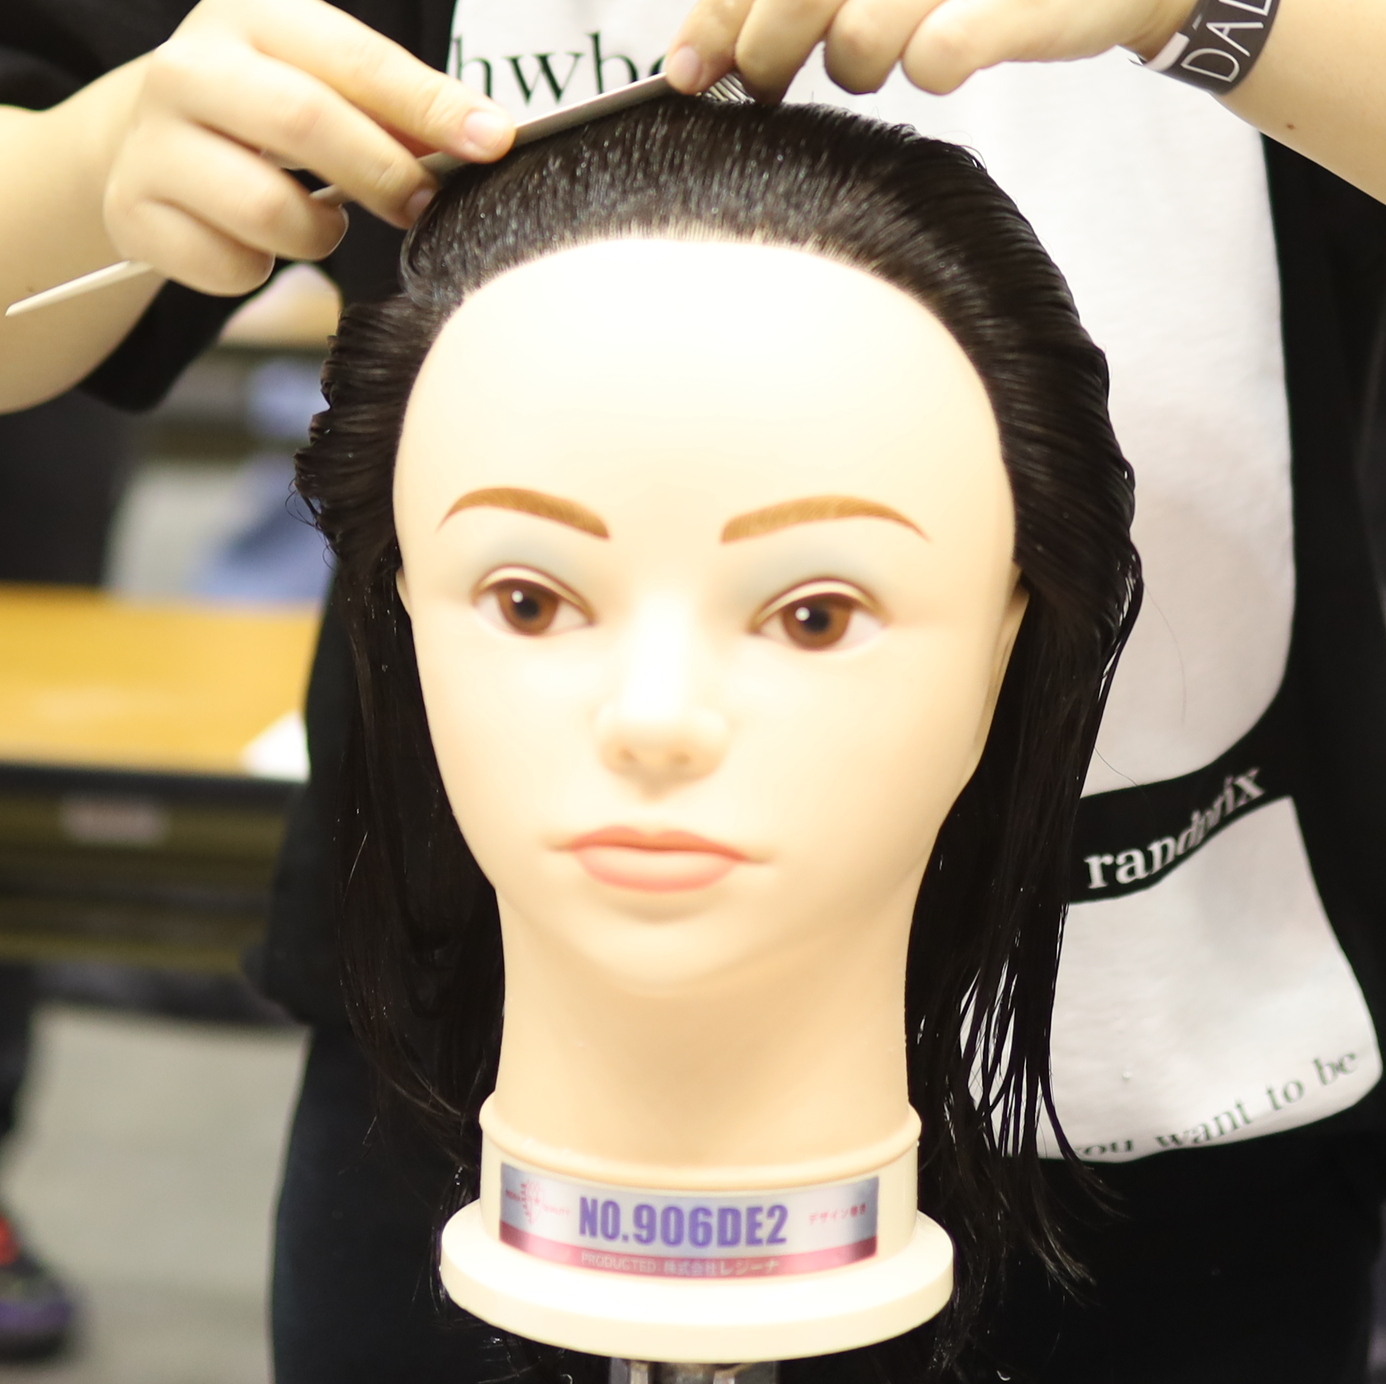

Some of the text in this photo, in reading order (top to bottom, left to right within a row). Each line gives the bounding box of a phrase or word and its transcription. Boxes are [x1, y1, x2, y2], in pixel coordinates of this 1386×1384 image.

[1076, 1052, 1357, 1157] ou want to be
[579, 1197, 789, 1248] NO.906DE2
